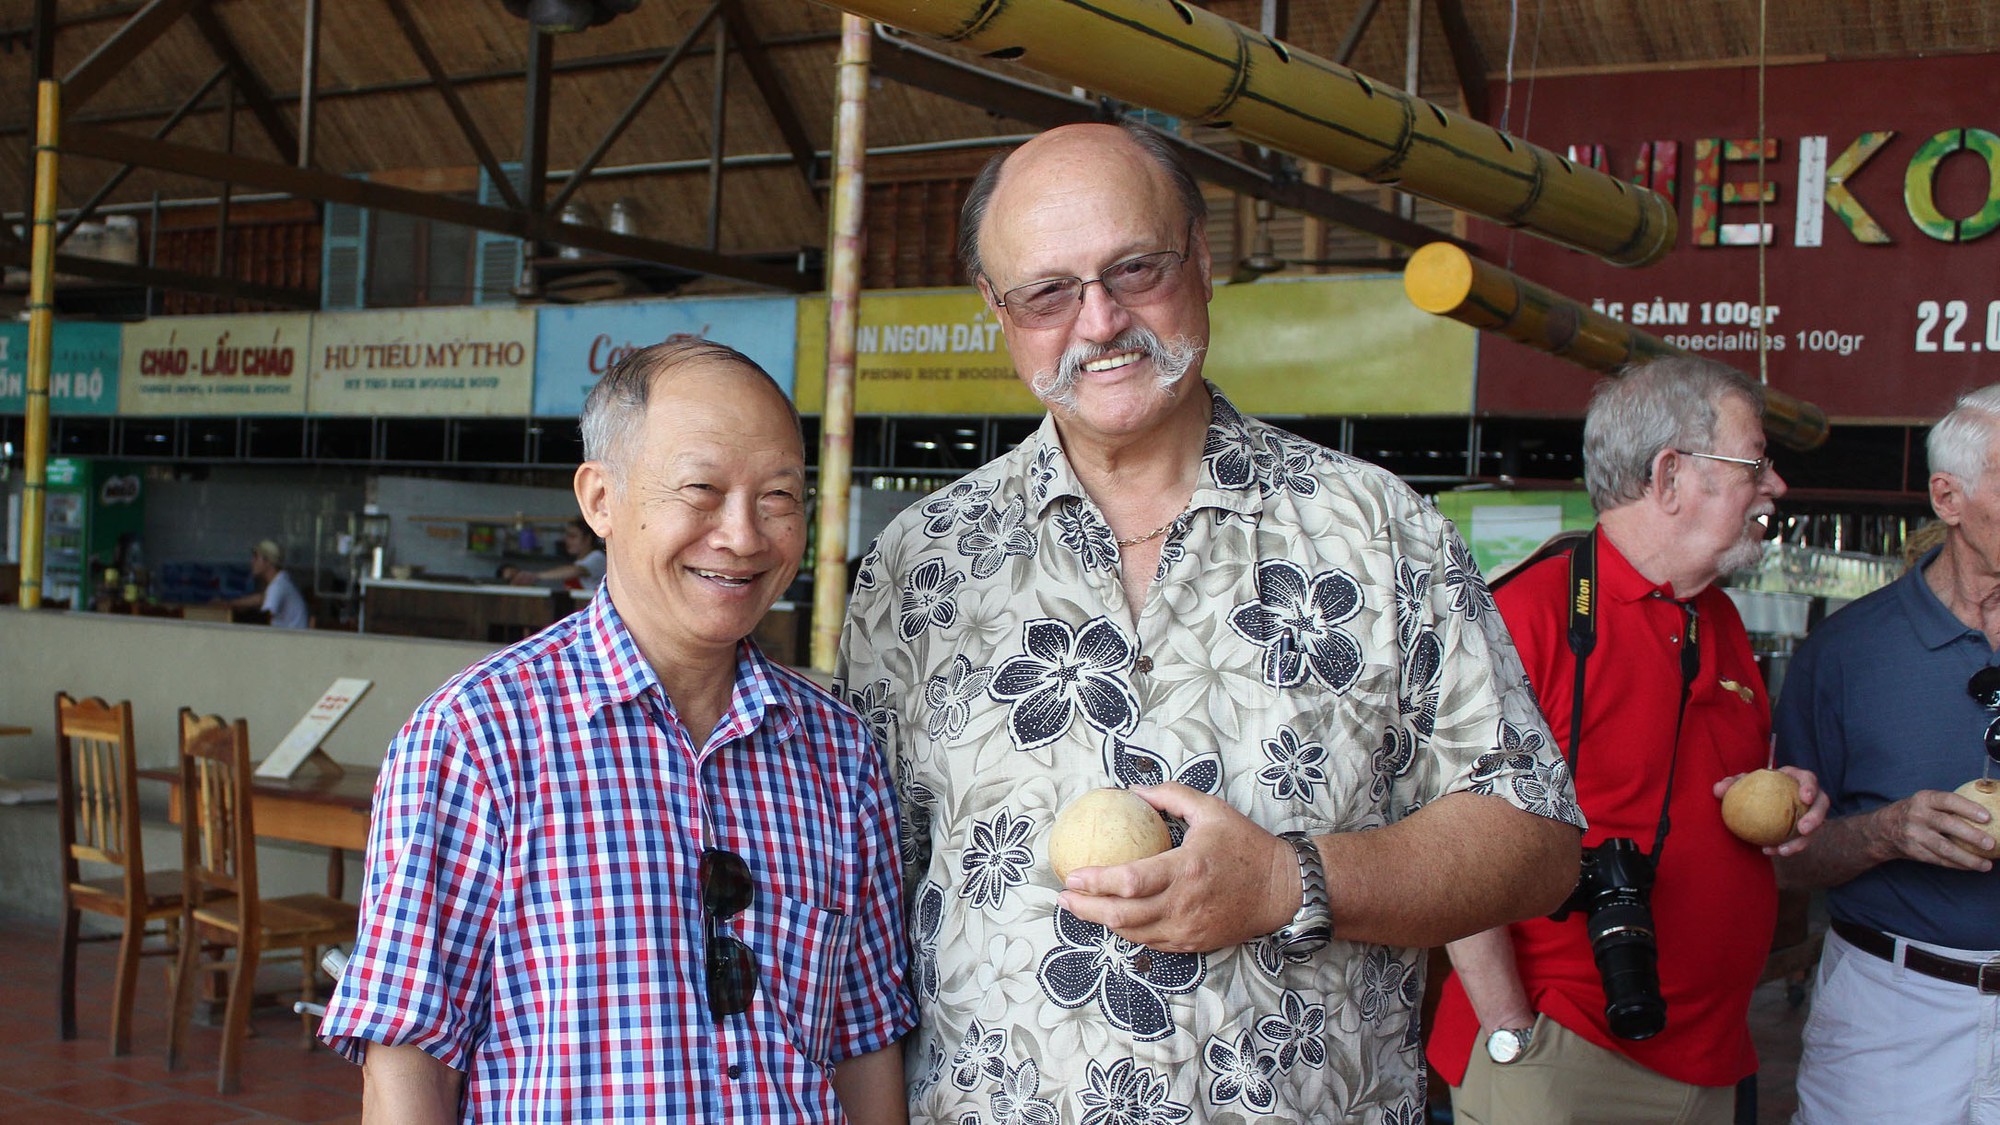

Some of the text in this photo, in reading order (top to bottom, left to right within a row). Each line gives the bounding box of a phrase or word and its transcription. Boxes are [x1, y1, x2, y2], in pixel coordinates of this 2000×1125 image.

[1700, 302, 1780, 328] 100gr
[883, 324, 948, 353] NGON
[1796, 330, 1864, 356] 100gr
[1576, 578, 1590, 615] Nikon
